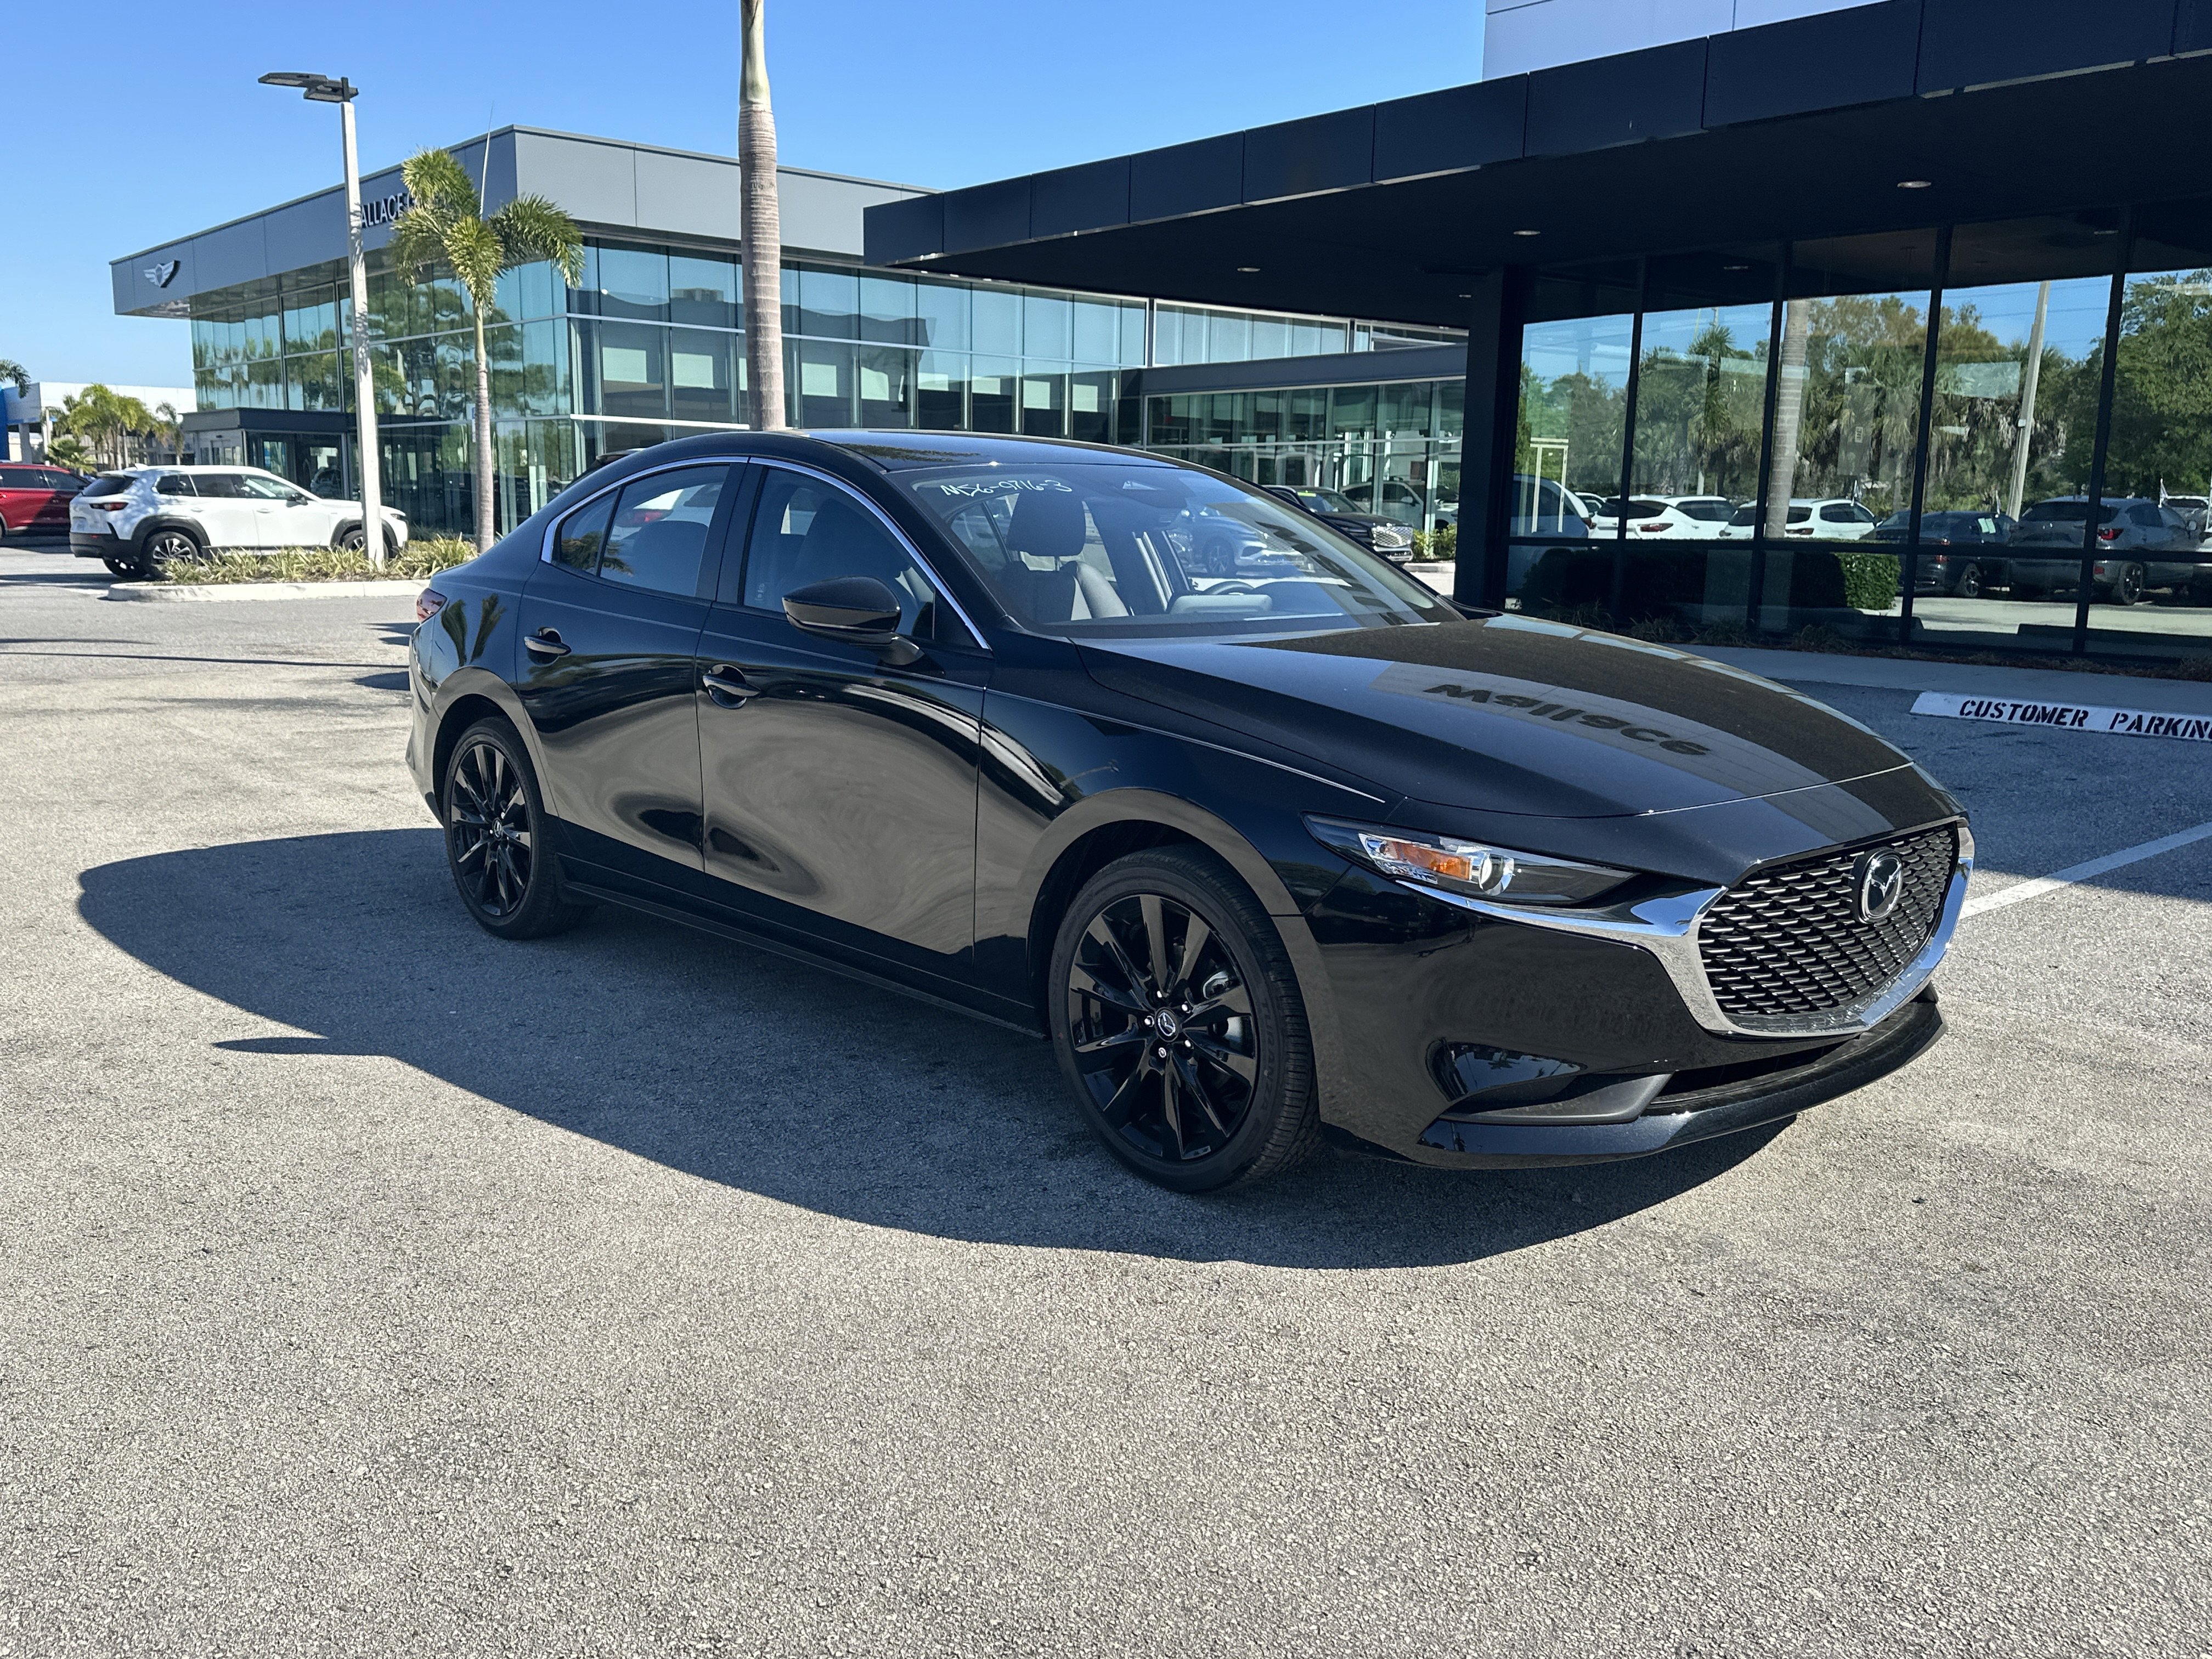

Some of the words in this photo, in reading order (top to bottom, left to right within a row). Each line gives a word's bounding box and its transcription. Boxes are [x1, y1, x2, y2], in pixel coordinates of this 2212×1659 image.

[361, 193, 404, 228] ALLACE
[1959, 699, 2089, 727] CUSTOMER
[2109, 713, 2212, 740] PARKIN
